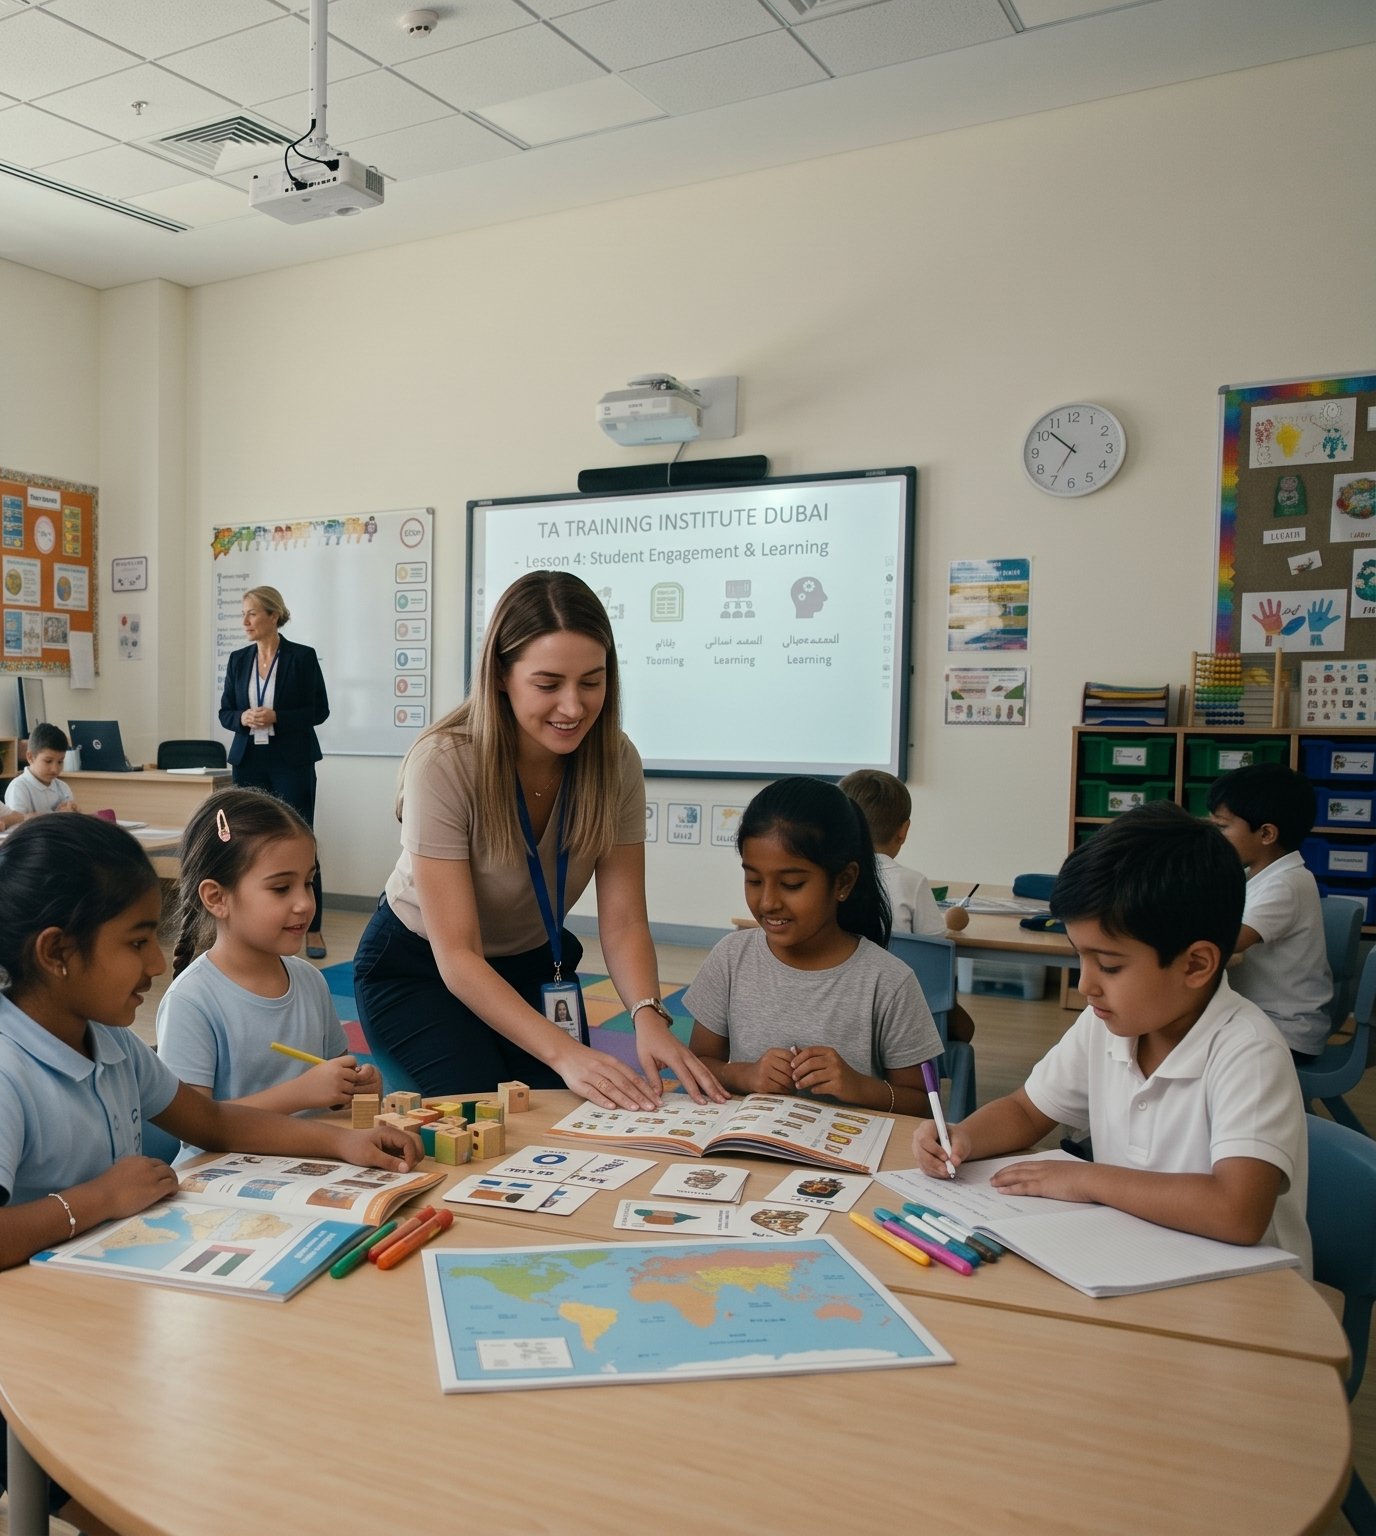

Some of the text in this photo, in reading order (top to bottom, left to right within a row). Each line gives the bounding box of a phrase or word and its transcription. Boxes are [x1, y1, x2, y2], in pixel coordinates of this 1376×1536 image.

[1068, 411, 1080, 423] 12
[1090, 415, 1094, 425] 1
[1050, 418, 1060, 429] 11
[1037, 430, 1050, 441] 10
[1100, 425, 1109, 436] 2
[1031, 448, 1039, 459] 9
[1105, 442, 1113, 454] 3
[1036, 464, 1045, 475] 8
[1098, 460, 1107, 470] 4
[1050, 475, 1058, 486] 7
[1067, 477, 1075, 489] 6
[1085, 472, 1094, 483] 5
[537, 502, 828, 539] TA TRAINING INSTITUTE DUBAI
[526, 555, 570, 568] Lesson
[573, 552, 586, 566] 4:
[590, 549, 644, 565] Student
[649, 544, 739, 565] Engagement
[744, 542, 756, 558] &
[761, 540, 829, 557] Learning
[713, 655, 756, 667] Learning
[787, 654, 832, 667] Learning
